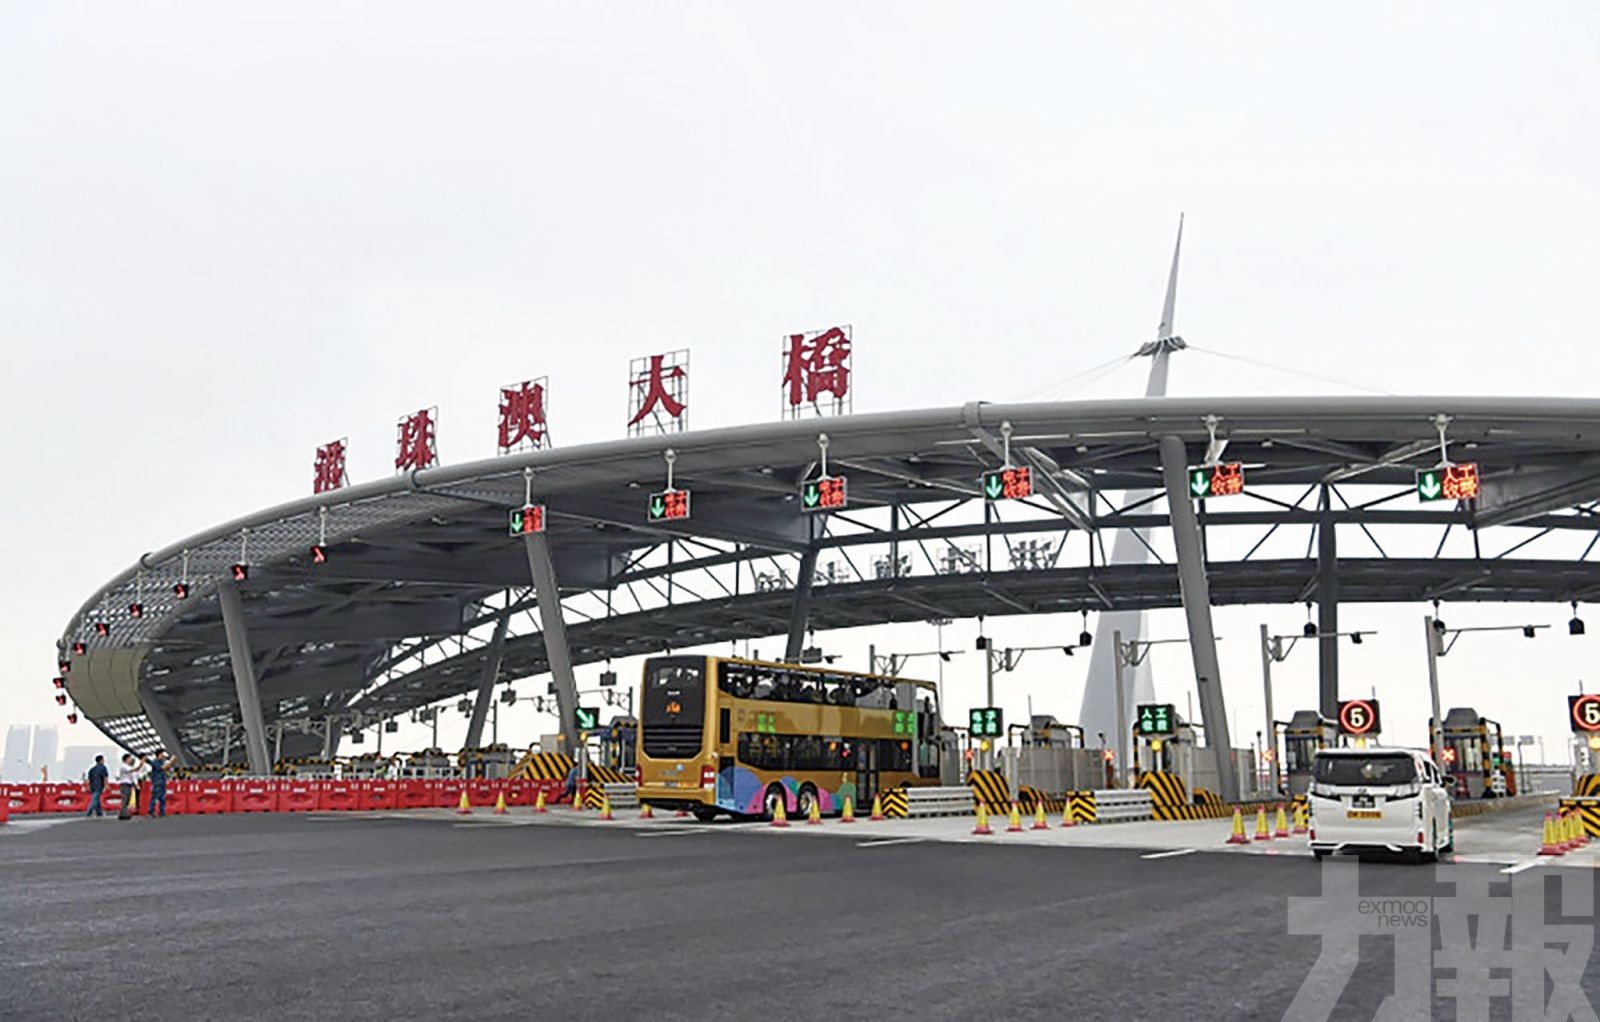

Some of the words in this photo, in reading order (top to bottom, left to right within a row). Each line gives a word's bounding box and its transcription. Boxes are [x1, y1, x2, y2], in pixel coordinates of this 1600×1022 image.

[1211, 463, 1241, 479] 人工
[1444, 463, 1476, 480] 人工
[1141, 707, 1167, 719] 人工
[1350, 707, 1364, 727] 5
[1585, 702, 1600, 724] 5
